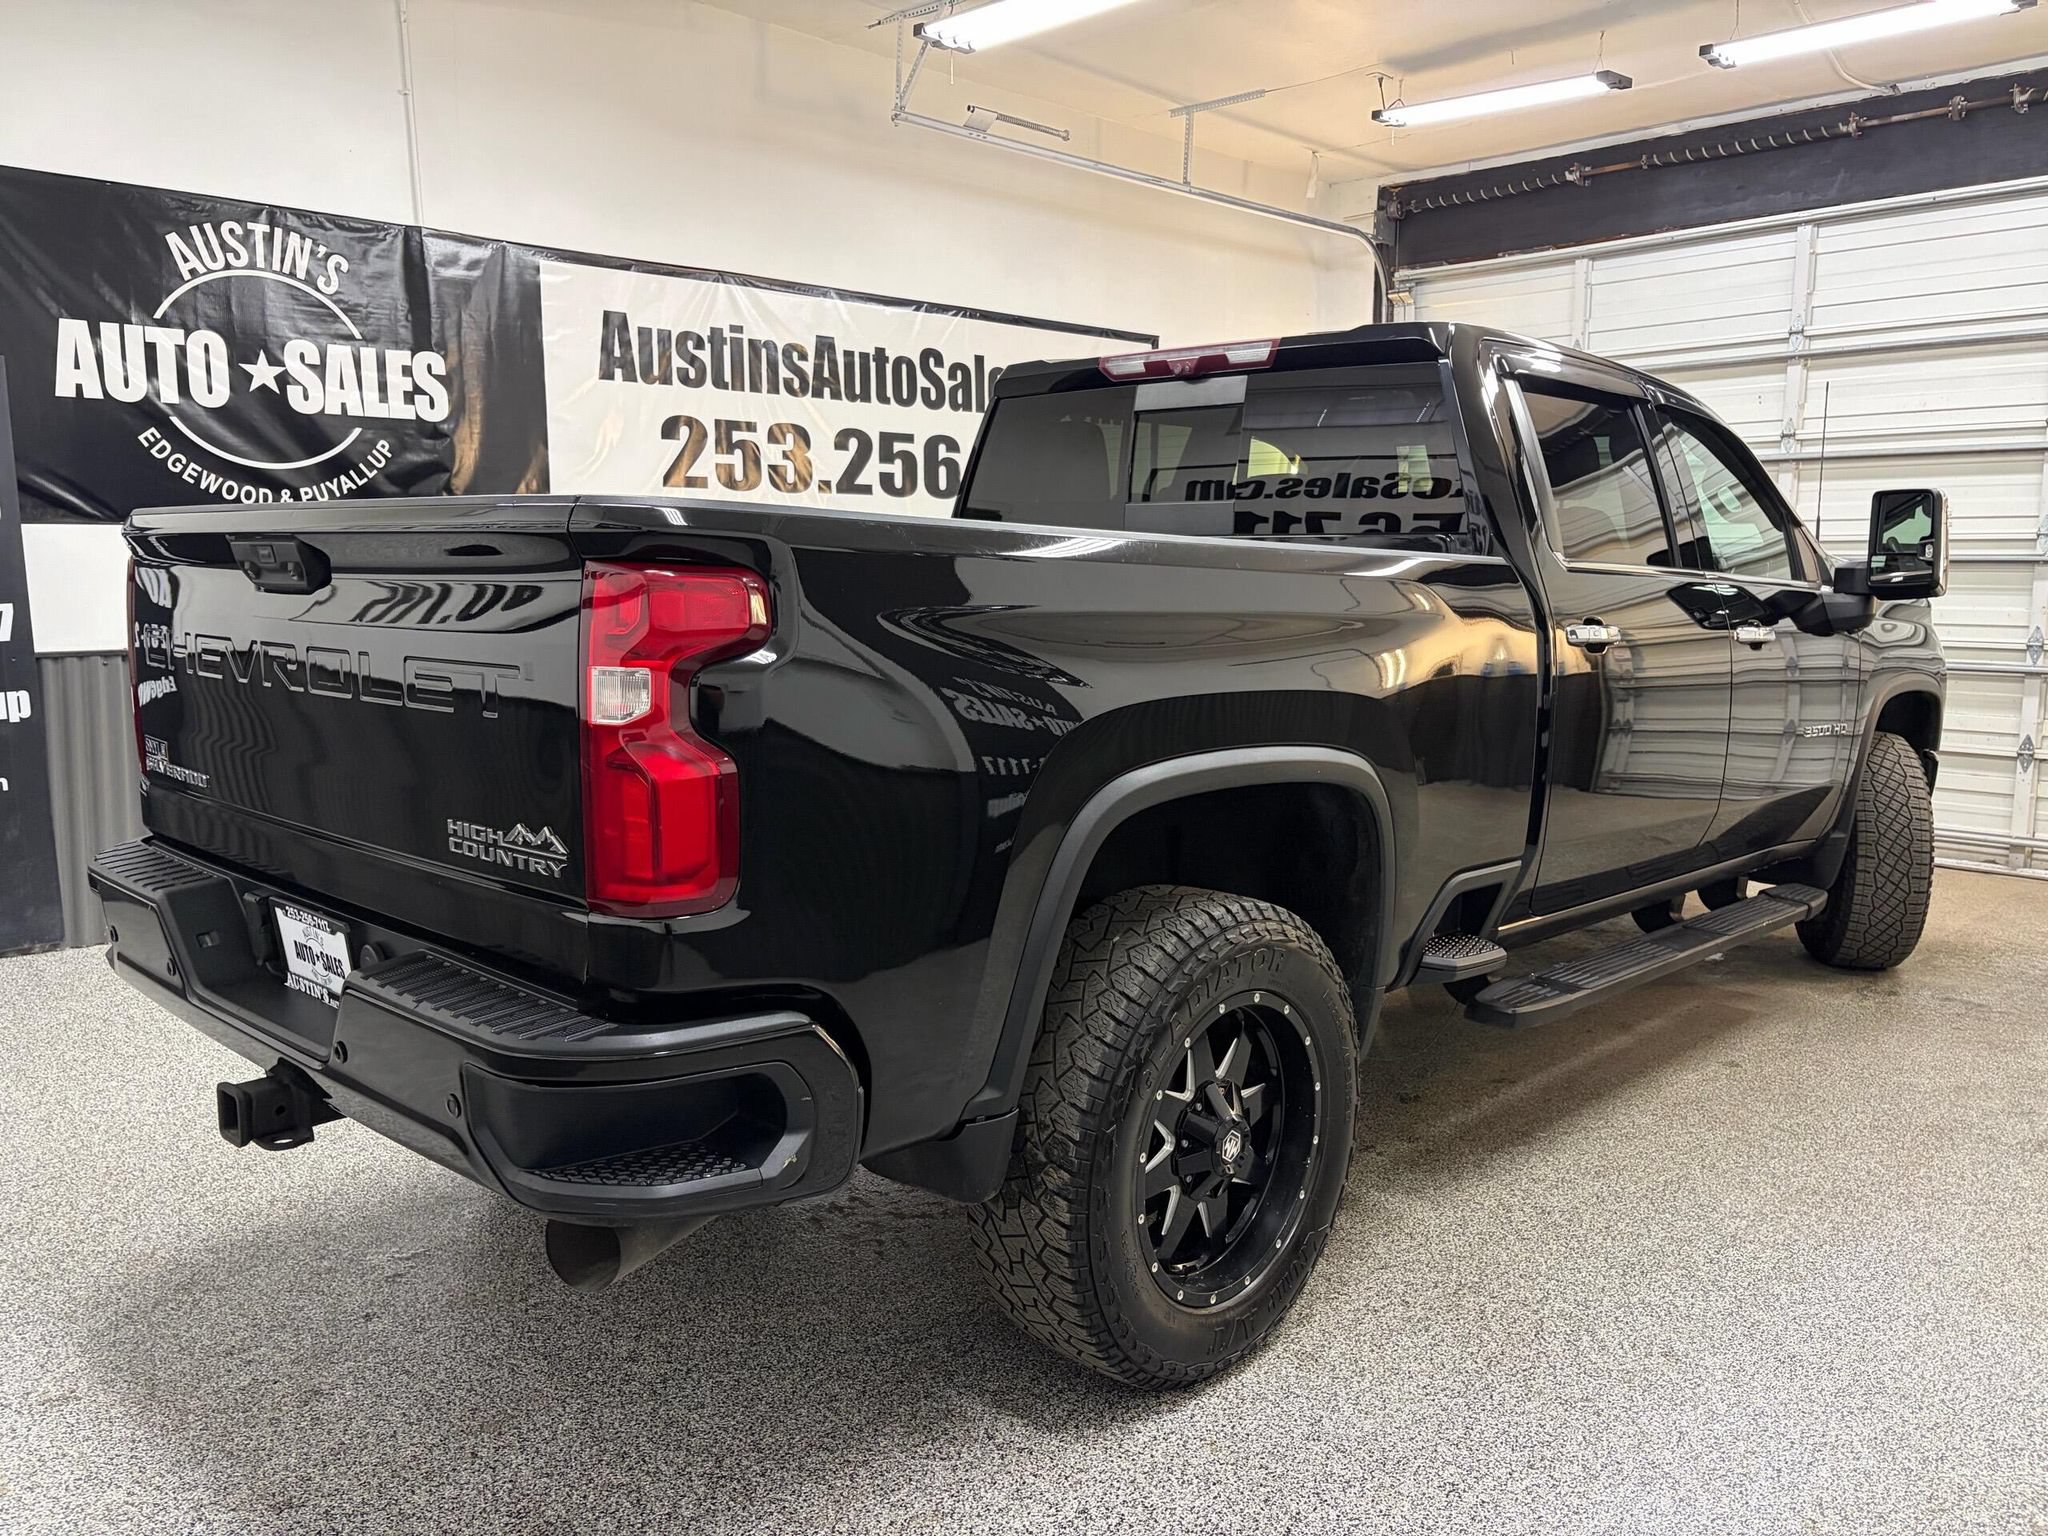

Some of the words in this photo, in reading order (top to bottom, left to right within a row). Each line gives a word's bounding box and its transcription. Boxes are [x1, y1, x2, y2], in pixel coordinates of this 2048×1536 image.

[165, 220, 349, 296] AUSTIN'S
[55, 318, 231, 408] AUTO
[284, 338, 450, 422] SALES
[137, 426, 273, 504] EDGEWOOD
[280, 488, 294, 503] &
[299, 439, 393, 503] PUYALLUP
[660, 414, 961, 499] 253.256
[144, 626, 521, 720] CHEVROLET
[1803, 725, 1831, 738] 3500
[1832, 723, 1848, 735] HD
[447, 819, 504, 846] HIGH
[448, 837, 568, 879] COUNTRY
[293, 939, 317, 967] AUTO
[319, 951, 346, 979] SALES
